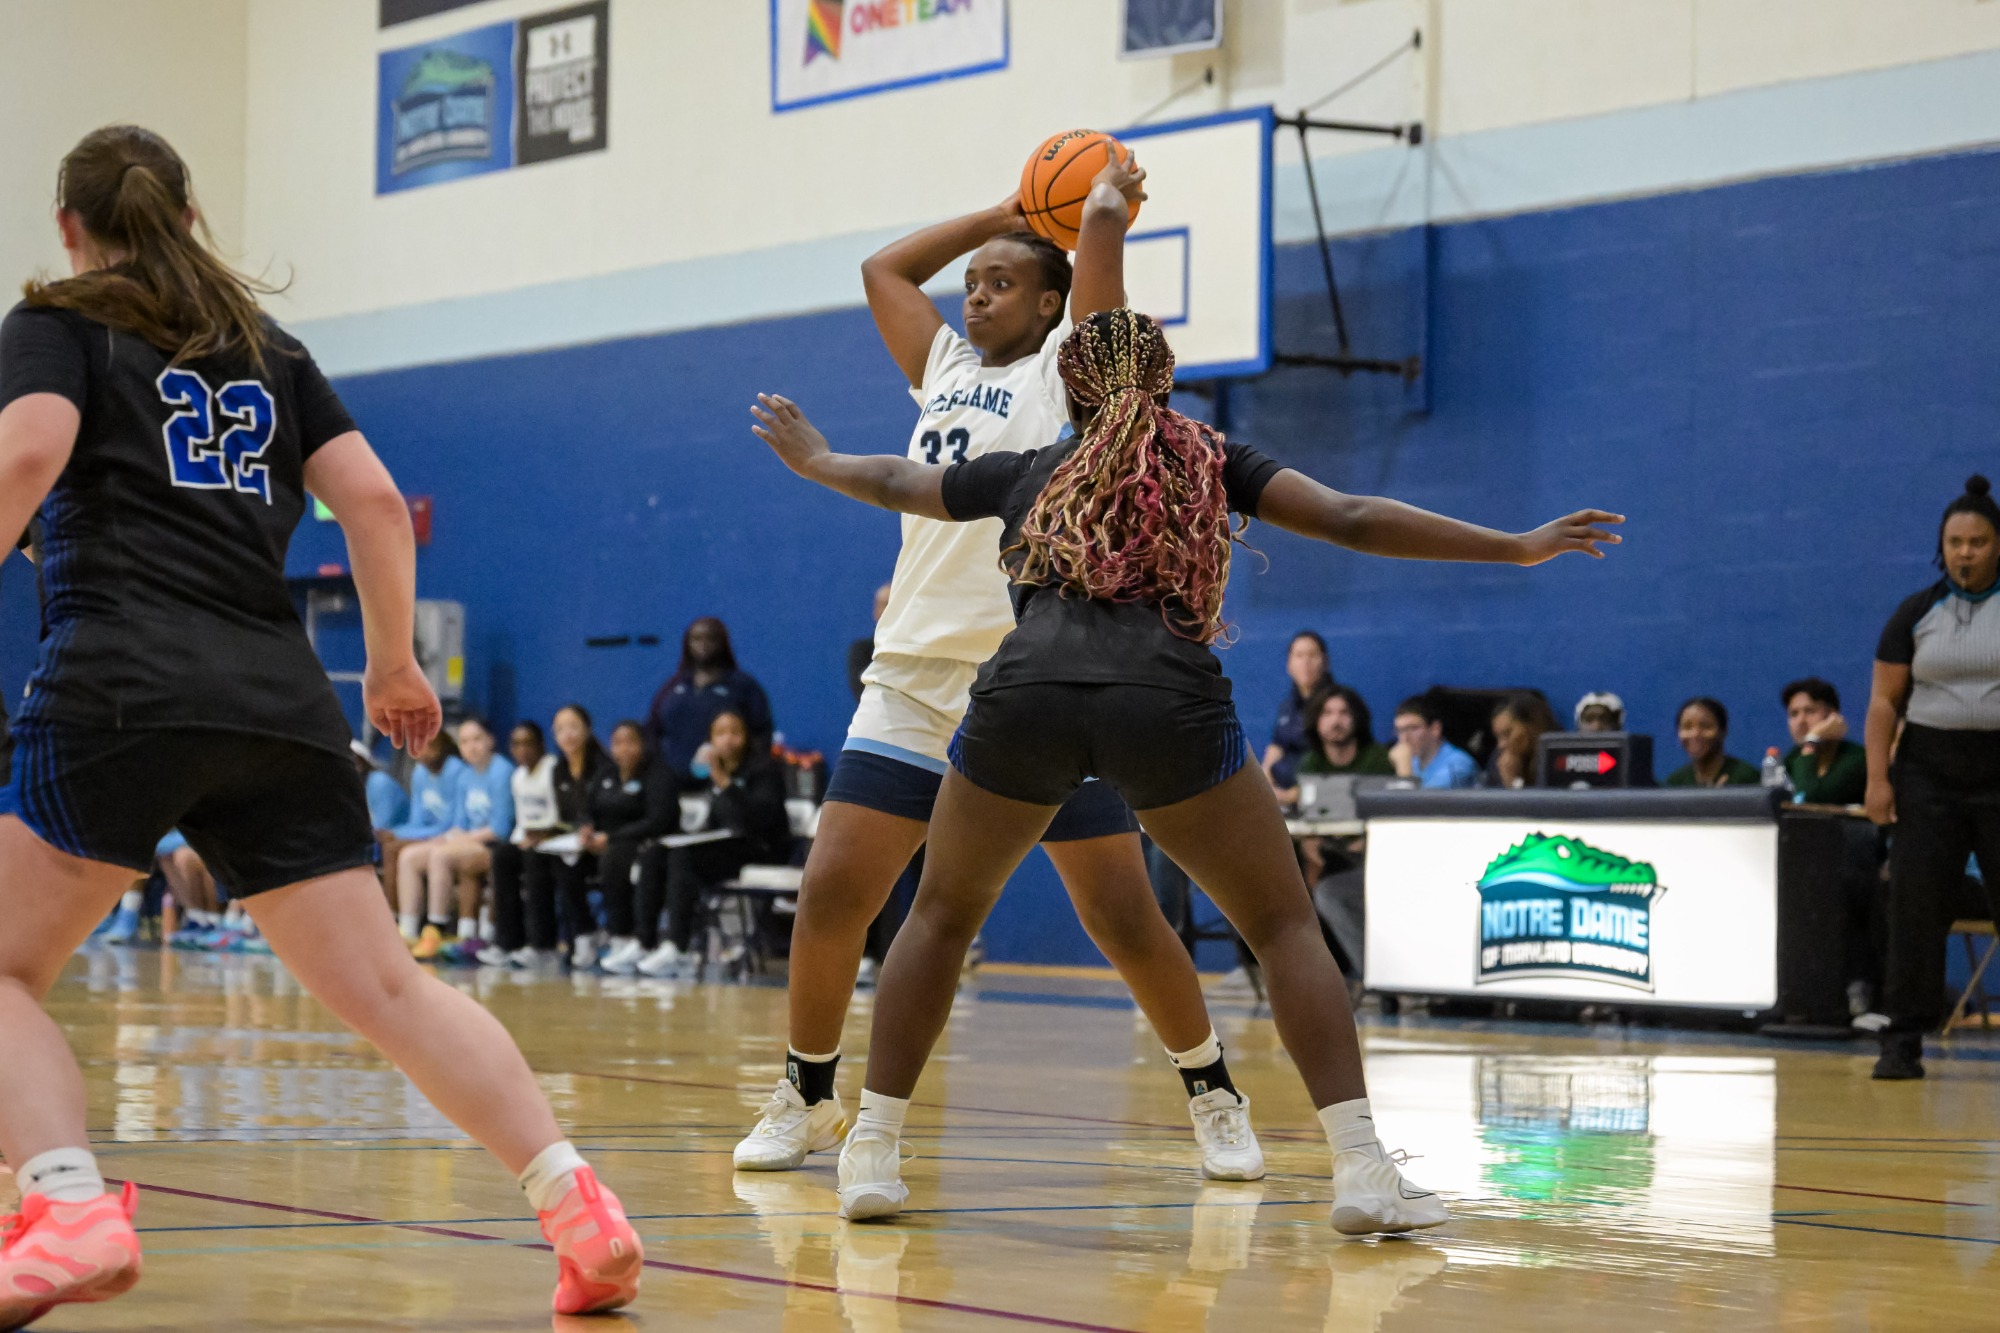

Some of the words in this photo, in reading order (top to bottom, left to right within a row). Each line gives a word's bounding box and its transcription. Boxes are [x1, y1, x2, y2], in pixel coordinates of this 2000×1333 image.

[156, 368, 277, 506] 22
[920, 427, 970, 465] 33
[1483, 898, 1563, 941] NOTRE
[1569, 896, 1649, 949] DAME
